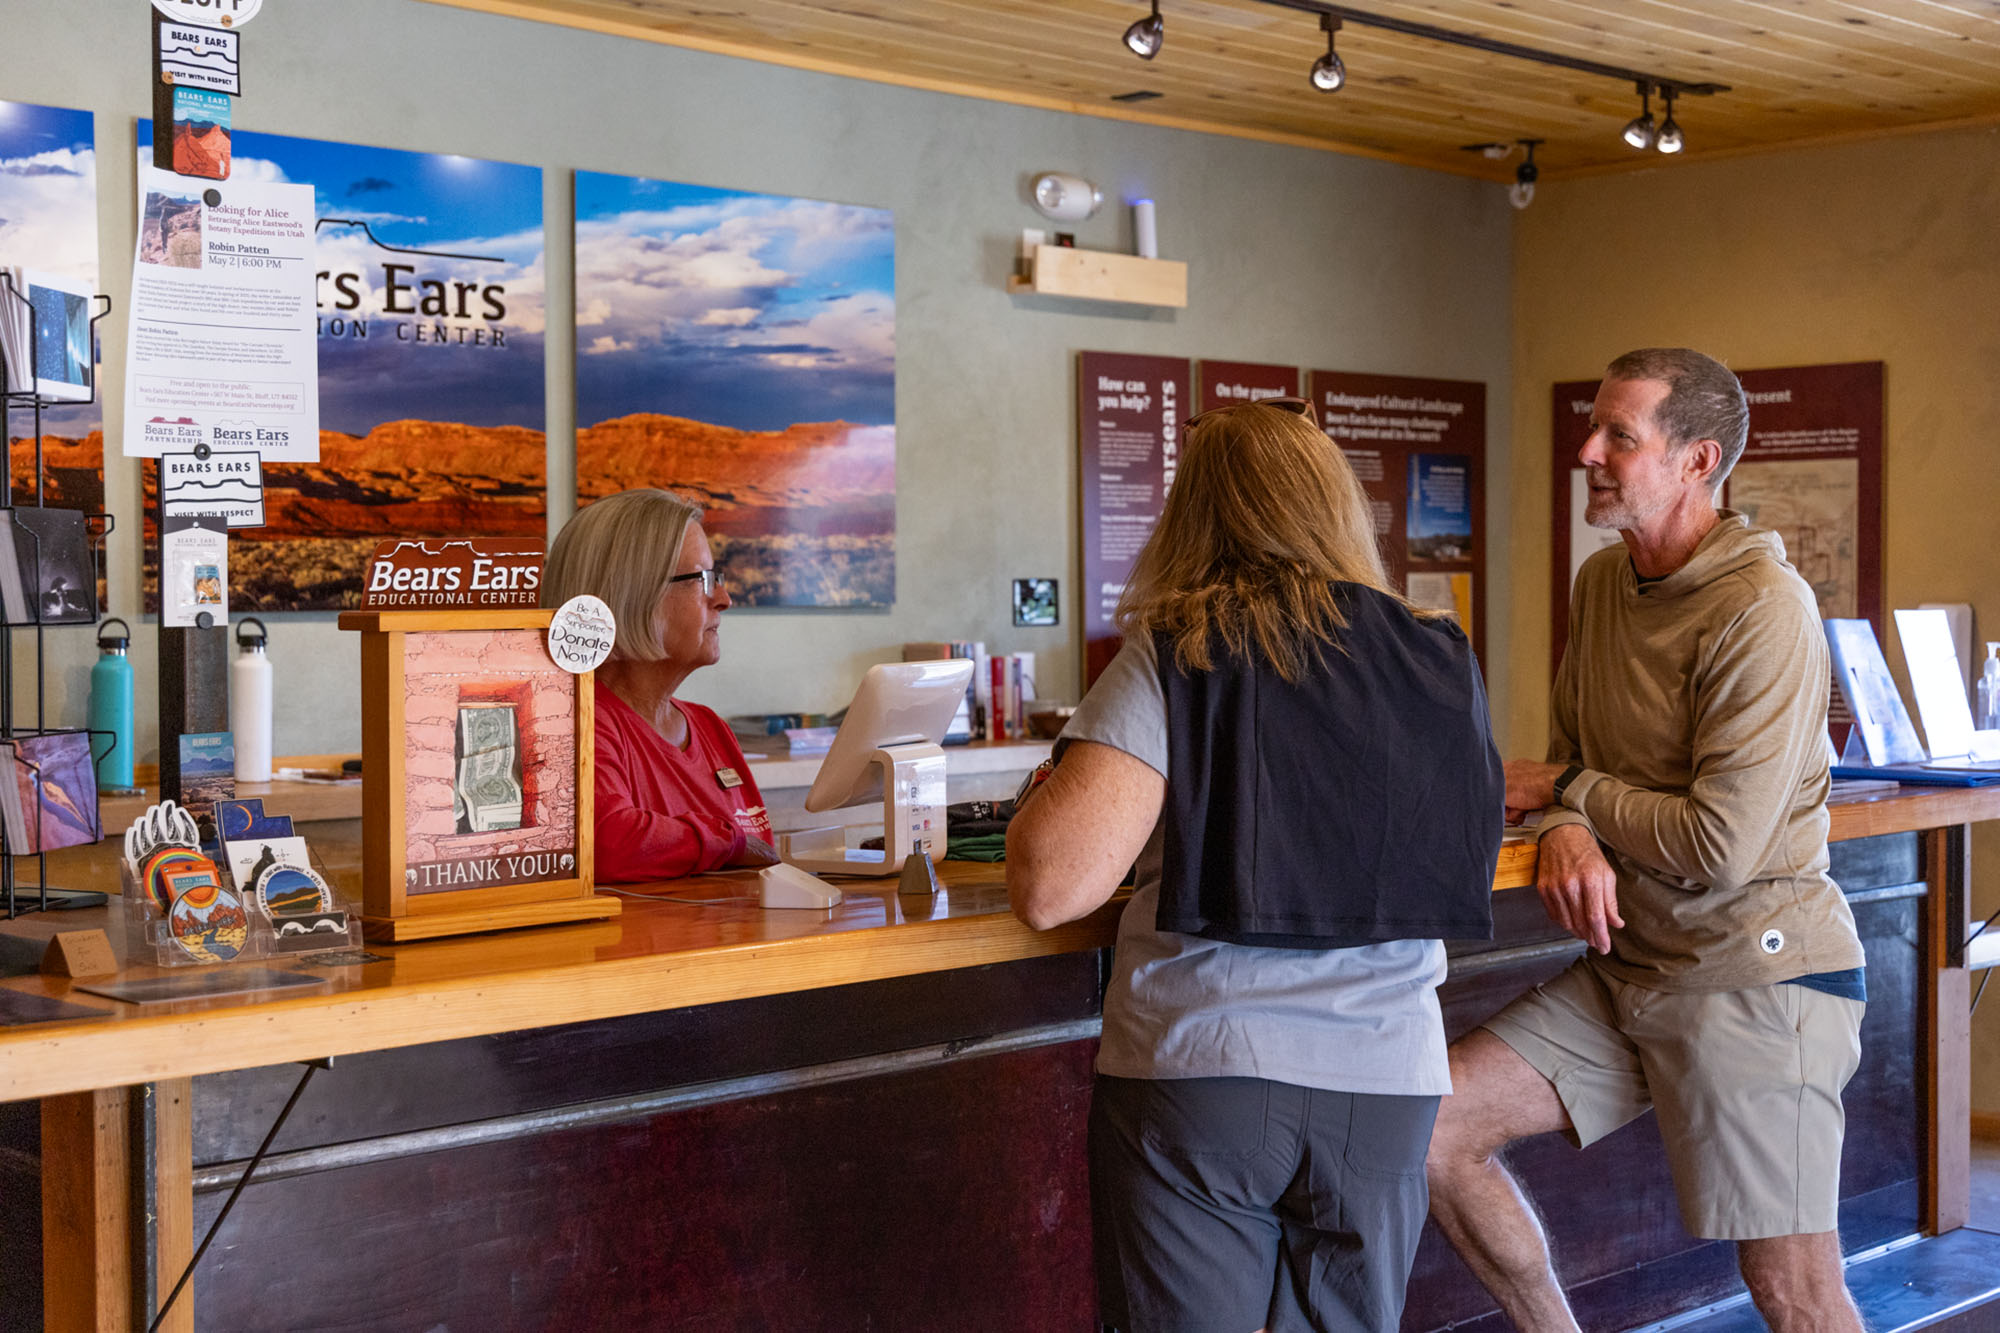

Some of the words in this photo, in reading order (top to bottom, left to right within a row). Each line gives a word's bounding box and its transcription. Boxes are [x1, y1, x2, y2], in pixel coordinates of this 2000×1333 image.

[171, 31, 200, 44] BEARS
[205, 37, 228, 48] EARS
[207, 76, 232, 86] RESPECT
[178, 91, 203, 101] BEARS
[208, 96, 228, 105] EARS
[208, 205, 246, 217] Looking
[248, 207, 262, 217] for
[264, 209, 289, 218] Alice
[208, 215, 241, 226] Retracing
[262, 220, 303, 228] Eastwood's
[208, 225, 231, 234] Botany
[234, 227, 275, 237] Expeditions
[209, 241, 235, 252] Robin
[238, 244, 270, 254] Patten
[209, 255, 229, 267] May
[229, 256, 236, 266] 2
[242, 258, 263, 268] 6:00
[265, 259, 282, 269] PM
[382, 263, 507, 321] Ears
[396, 322, 506, 348] CENTER
[1098, 376, 1124, 392] How
[1125, 380, 1146, 393] can
[1216, 382, 1232, 398] On
[1232, 383, 1249, 399] the
[1250, 386, 1286, 402] ground
[1097, 396, 1119, 412] you
[1120, 394, 1152, 414] help?
[1326, 391, 1380, 411] Endangered
[1382, 395, 1418, 410] Cultural
[145, 424, 174, 436] Bears
[177, 426, 202, 437] Ears
[213, 428, 252, 440] Bears
[256, 429, 289, 441] Ears
[145, 436, 202, 445] PARTNERSHIP
[171, 463, 212, 474] BEARS
[218, 462, 251, 473] EARS
[197, 510, 218, 518] WITH
[220, 509, 254, 518] RESPECT
[368, 561, 462, 592] Bears
[469, 559, 540, 591] Ears
[368, 592, 475, 606] EDUCATIONAL
[480, 592, 537, 604] CENTER
[576, 603, 589, 614] Be
[592, 607, 600, 617] A
[551, 625, 610, 652] Donate
[556, 644, 598, 666] Now!
[750, 814, 769, 827] Ear
[420, 858, 501, 887] THANK
[506, 853, 558, 878] YOU!
